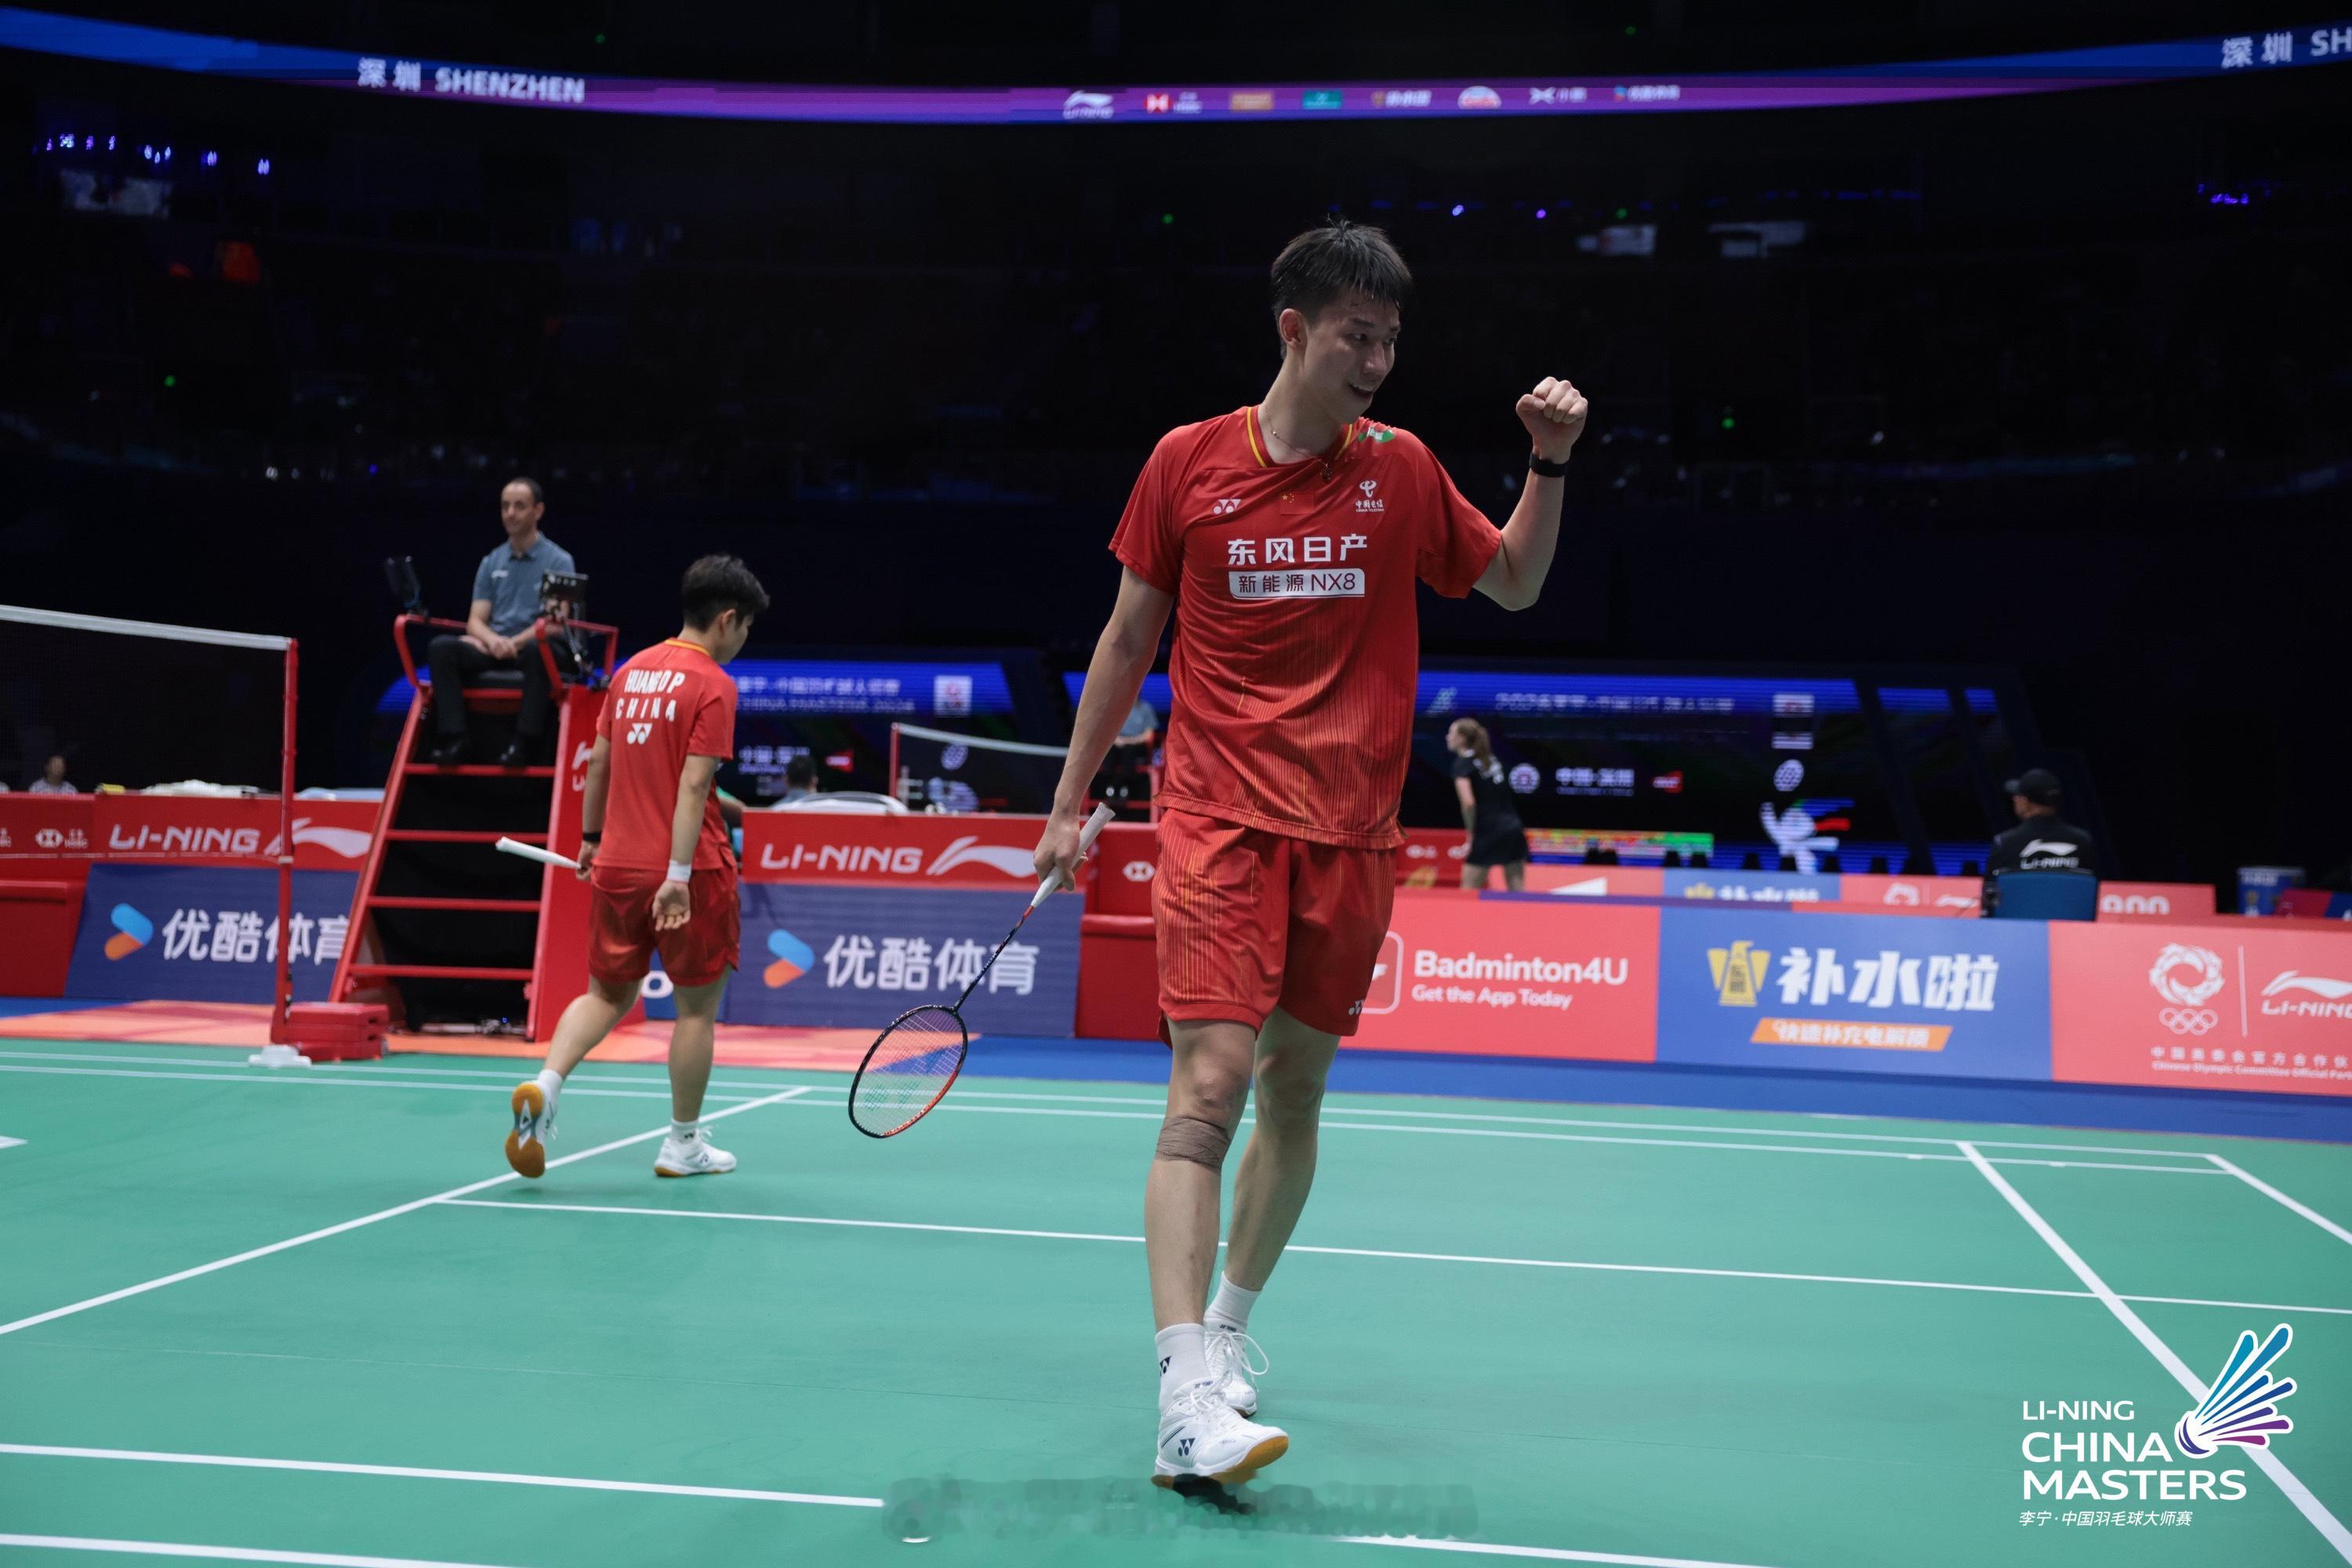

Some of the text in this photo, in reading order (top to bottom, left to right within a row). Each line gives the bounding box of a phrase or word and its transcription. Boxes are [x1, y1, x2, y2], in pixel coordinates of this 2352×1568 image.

[435, 67, 585, 103] SHENZHEN
[1227, 533, 1367, 565] 东风日产
[1239, 572, 1356, 593] 新能源 NX8
[615, 697, 677, 722] CHINA
[108, 824, 260, 853] LI-NING
[760, 843, 923, 874] LI-NING
[823, 935, 1040, 996] 优酷体育
[1414, 949, 1629, 985] Badminton4U
[1776, 947, 1999, 1011] 补水啦
[1411, 983, 1573, 1011] Get the App Today
